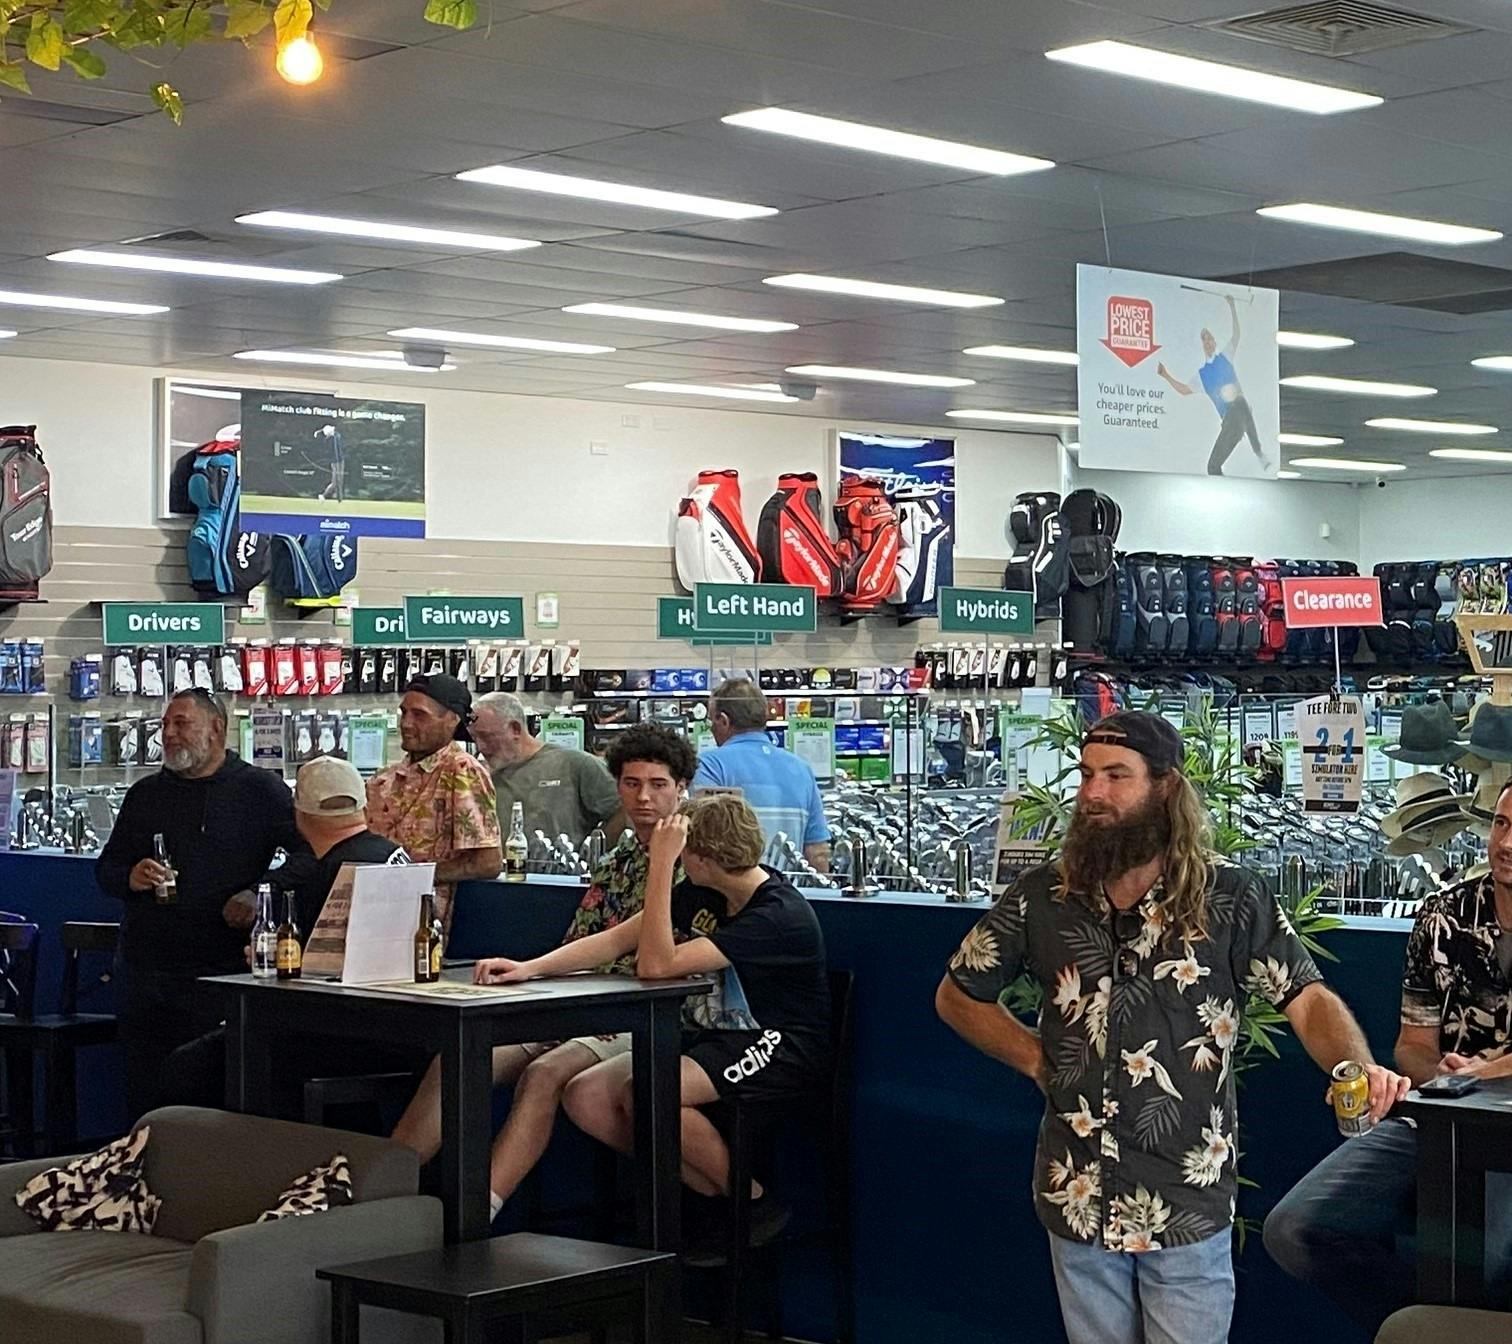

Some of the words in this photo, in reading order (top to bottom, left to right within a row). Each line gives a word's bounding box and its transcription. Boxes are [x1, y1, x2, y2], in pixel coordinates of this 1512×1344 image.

[1110, 303, 1150, 320] LOWEST
[1111, 317, 1150, 338] PRICE
[1112, 337, 1149, 350] GUARANTEE
[1098, 382, 1124, 397] You'll
[1126, 385, 1147, 399] love
[1148, 388, 1164, 400] our
[1096, 398, 1134, 414] cheaper
[1136, 402, 1167, 416] prices.
[1103, 414, 1160, 430] Guaranteed.
[783, 527, 830, 587] TaylorMade
[707, 595, 750, 616] Left
[753, 596, 804, 617] Hand
[1293, 590, 1373, 610] Clearance
[421, 606, 511, 629] Fairways
[955, 599, 1018, 622] Hybrids
[128, 612, 202, 632] Drivers
[1306, 703, 1322, 715] TEE
[1323, 702, 1342, 714] FORE
[547, 722, 578, 730] SPECIAL
[795, 721, 828, 730] SPECIAL
[1314, 727, 1329, 763] 2
[1341, 727, 1354, 763] 1
[1311, 763, 1343, 775] SIMULATOR
